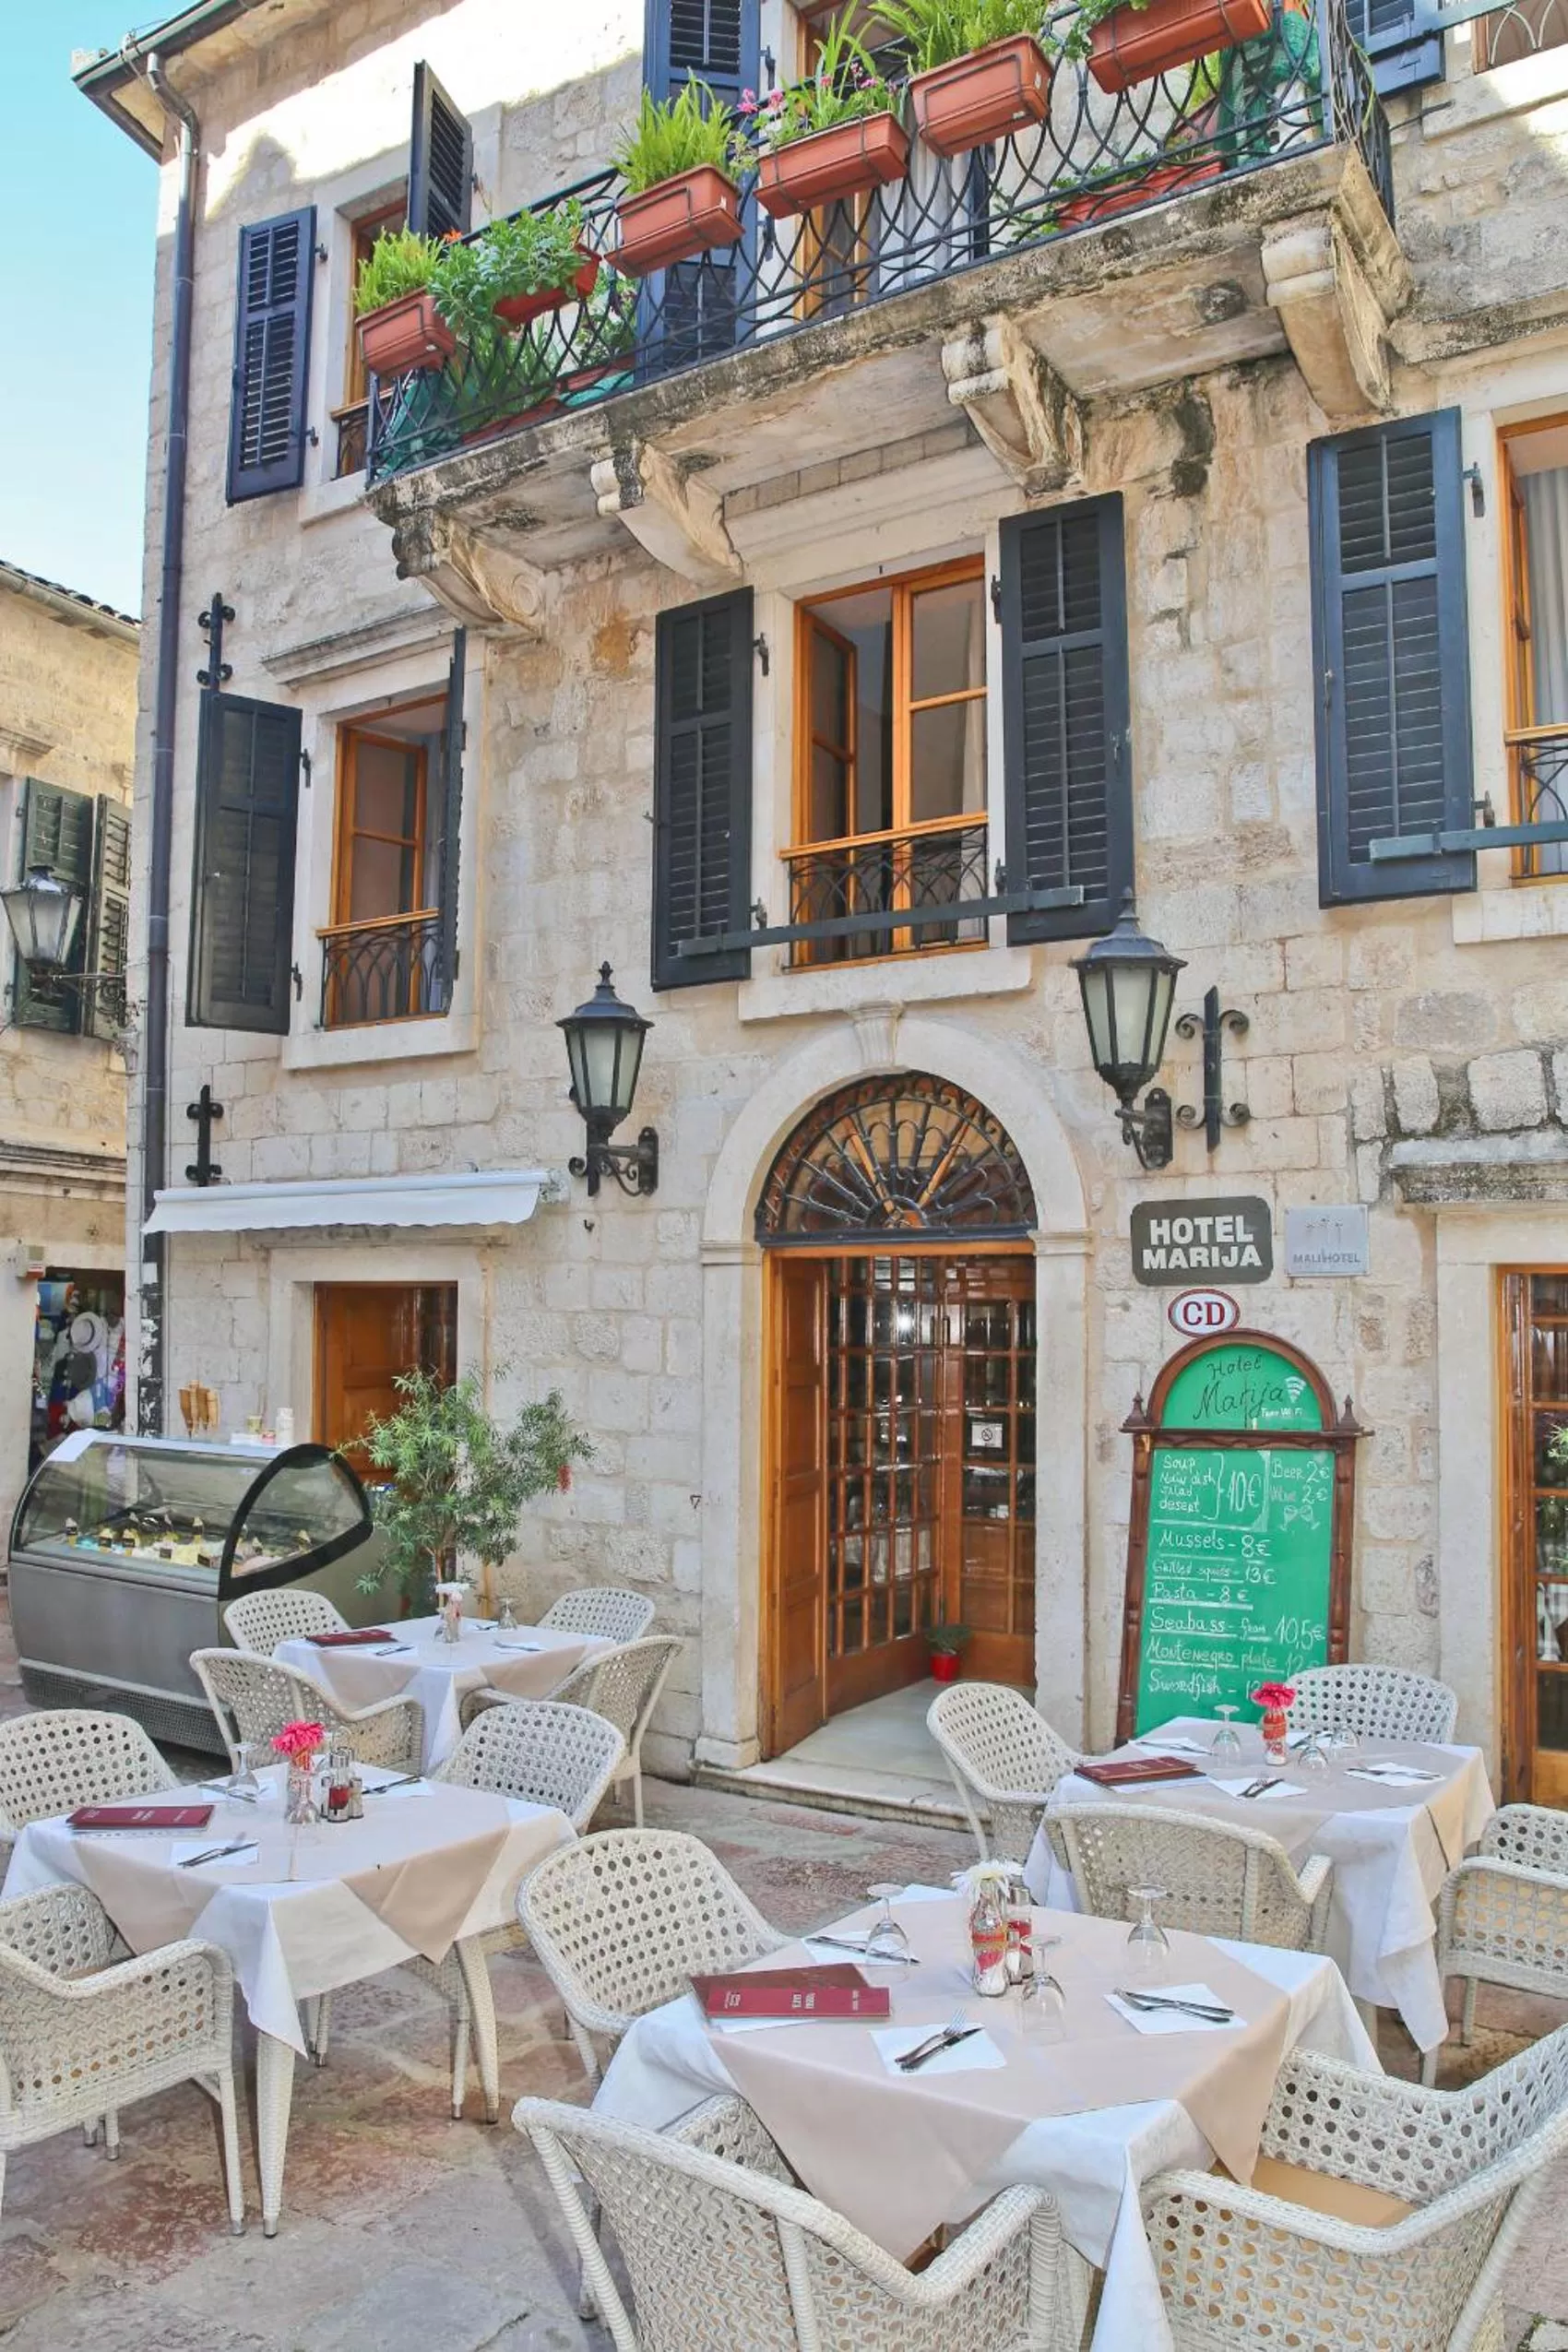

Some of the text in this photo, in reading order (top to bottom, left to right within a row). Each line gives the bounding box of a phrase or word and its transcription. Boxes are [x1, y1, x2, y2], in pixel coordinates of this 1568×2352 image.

[1149, 1215, 1254, 1245] HOTEL
[1142, 1245, 1263, 1270] MARIJA
[1293, 1253, 1361, 1263] MALI HOTEL
[1182, 1301, 1226, 1325] CD
[1206, 1353, 1263, 1381] Hotel
[1193, 1380, 1284, 1420] Marija
[1163, 1455, 1195, 1474] Soup
[1272, 1457, 1305, 1480] Beer
[1191, 1467, 1216, 1486] dish
[1159, 1495, 1200, 1513] desert
[1158, 1529, 1225, 1550] Mussels
[1152, 1581, 1196, 1600] Pasta
[1146, 1635, 1233, 1670] Montenegro
[1241, 1645, 1277, 1672] plate
[1148, 1668, 1222, 1702] Swordfish
